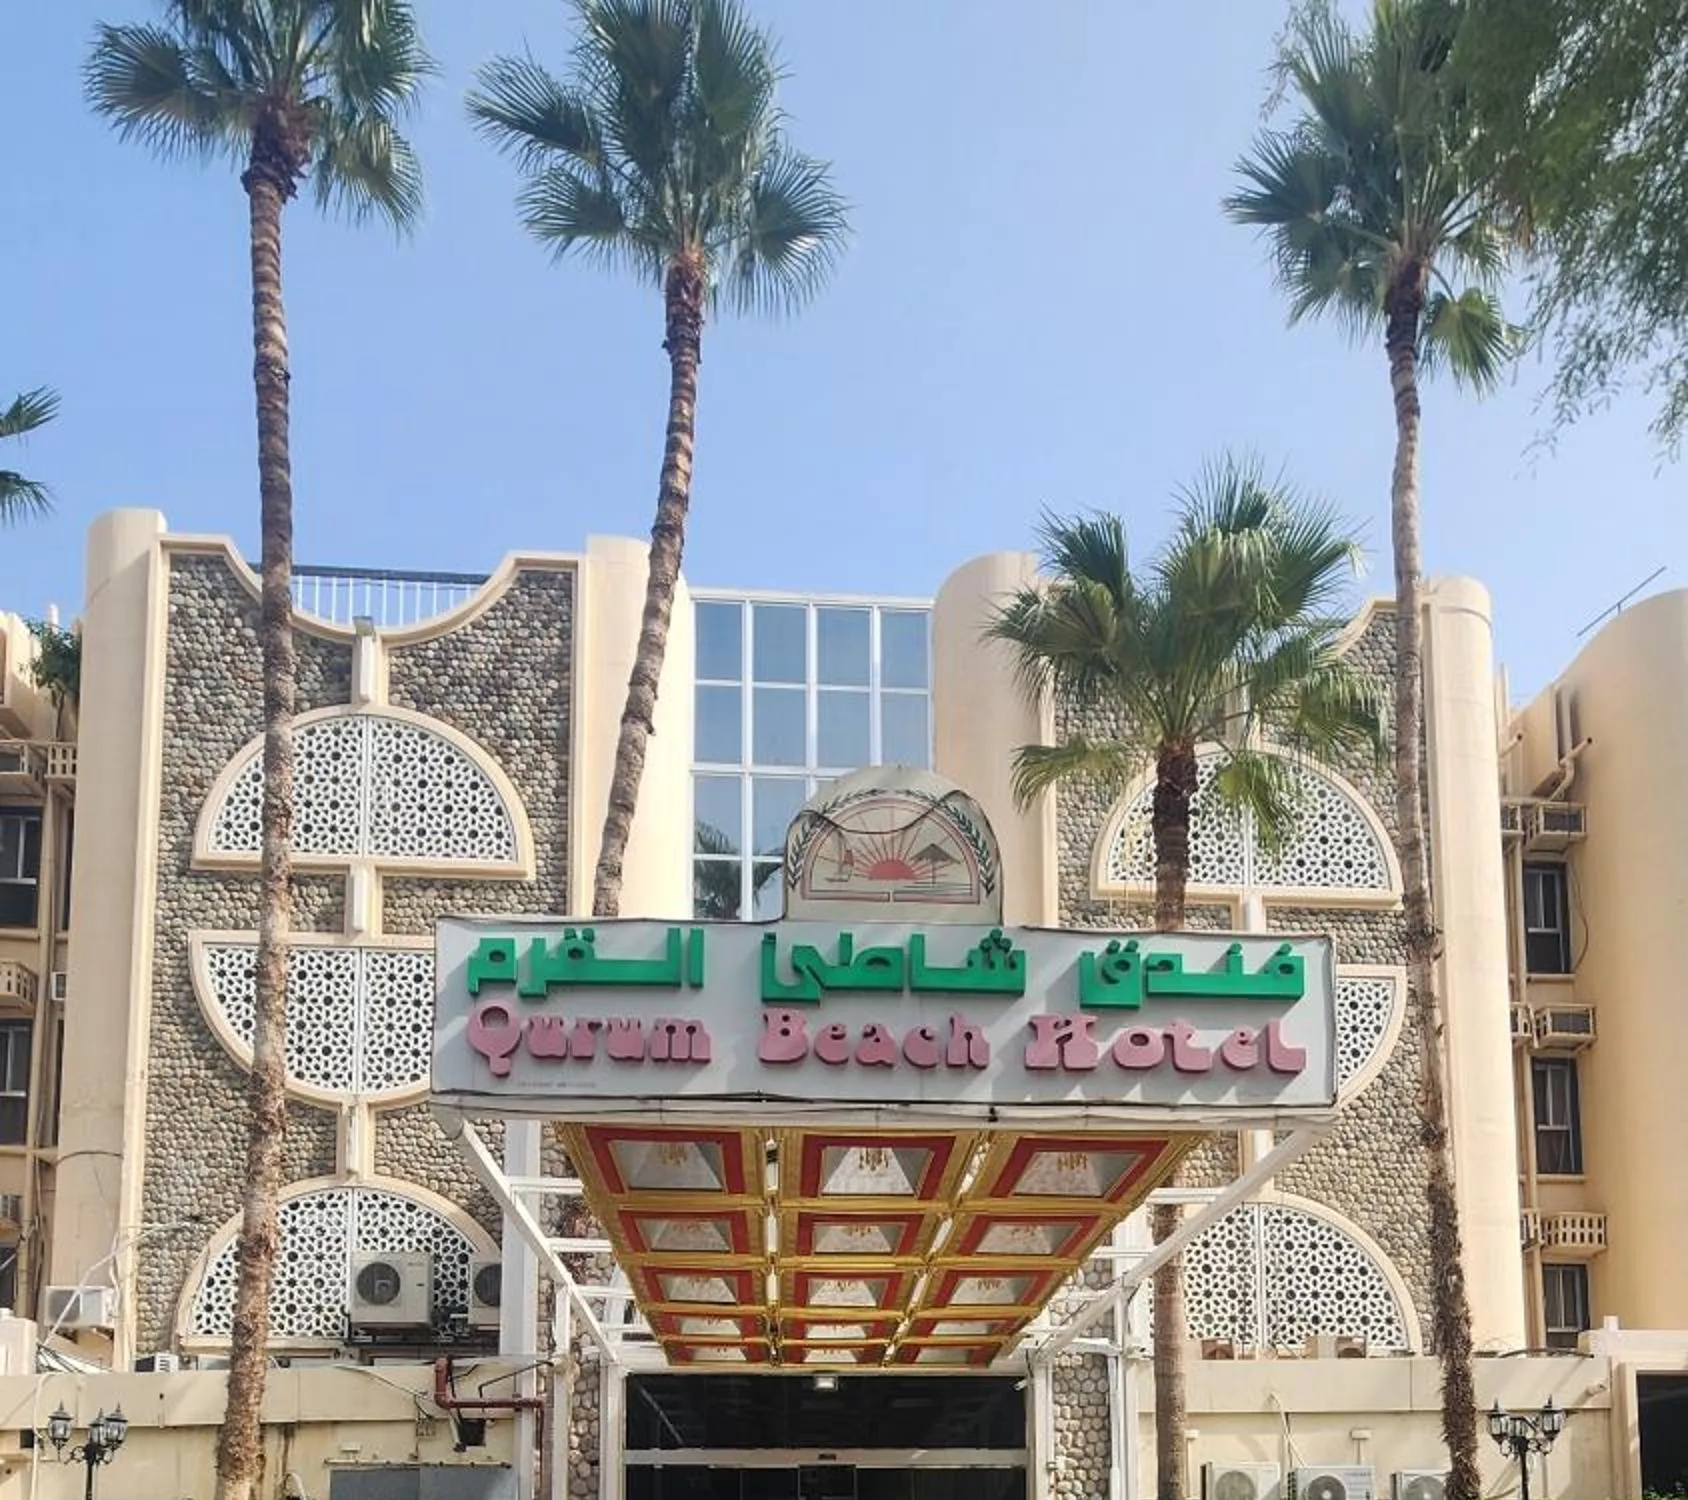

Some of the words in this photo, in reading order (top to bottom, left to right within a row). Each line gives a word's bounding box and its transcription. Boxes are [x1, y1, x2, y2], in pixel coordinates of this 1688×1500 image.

[467, 926, 704, 999] القرم
[1079, 938, 1305, 1009] فندق
[467, 999, 711, 1078] Qurum
[758, 1006, 989, 1070] Beach
[1024, 1012, 1307, 1074] Hotel
